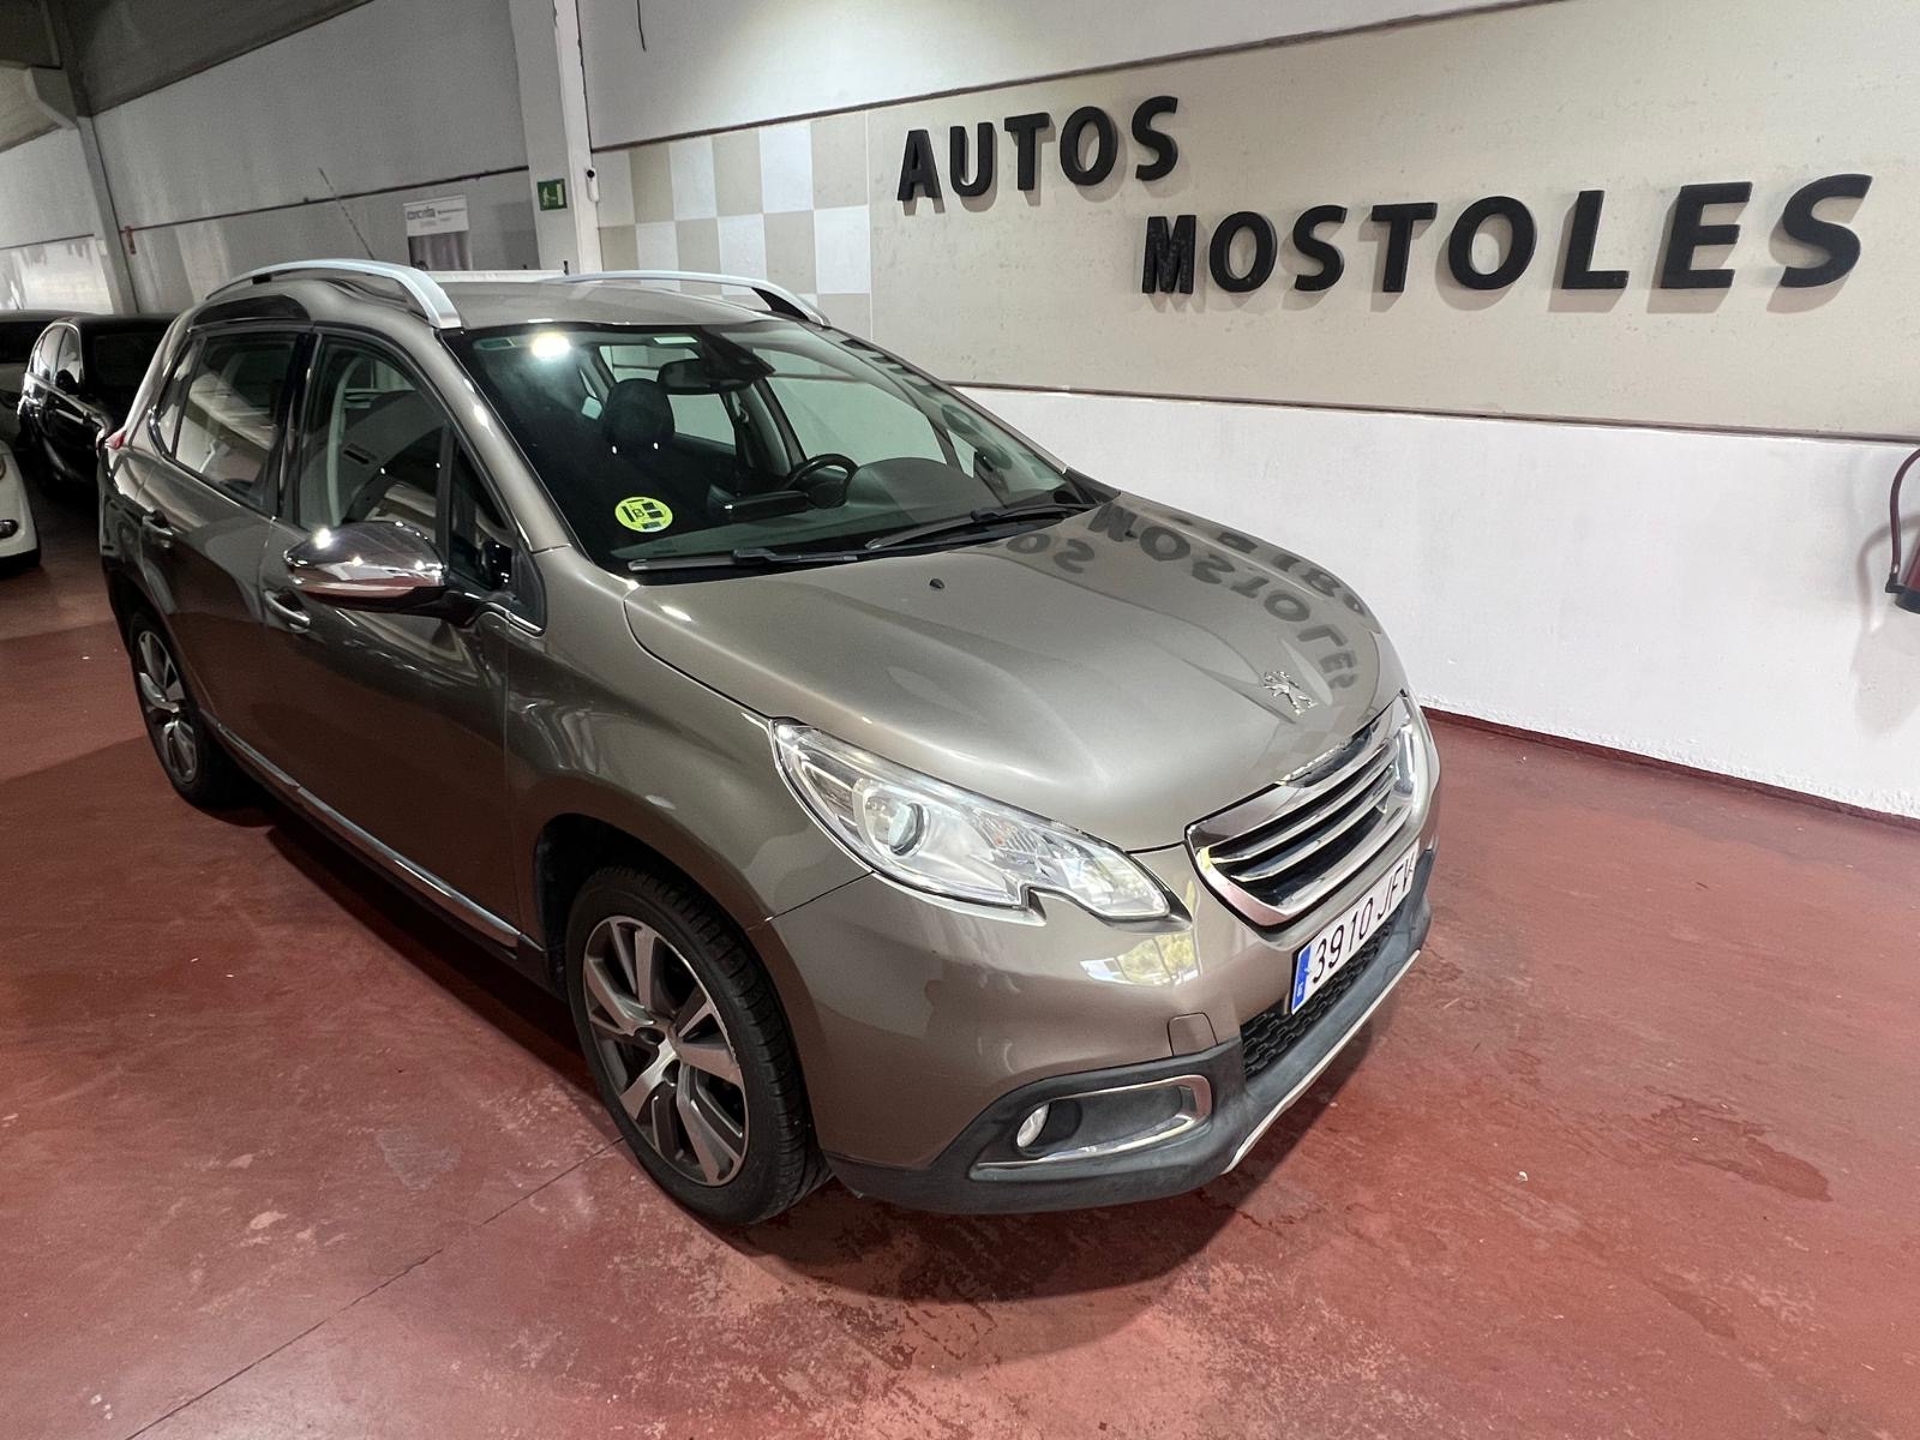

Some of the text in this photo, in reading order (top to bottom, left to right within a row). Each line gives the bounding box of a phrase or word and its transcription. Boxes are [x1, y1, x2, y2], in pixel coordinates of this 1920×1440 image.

[897, 95, 1179, 201] AUTOS
[1141, 174, 1873, 295] MOSTOLES
[1312, 897, 1374, 984] 3910
